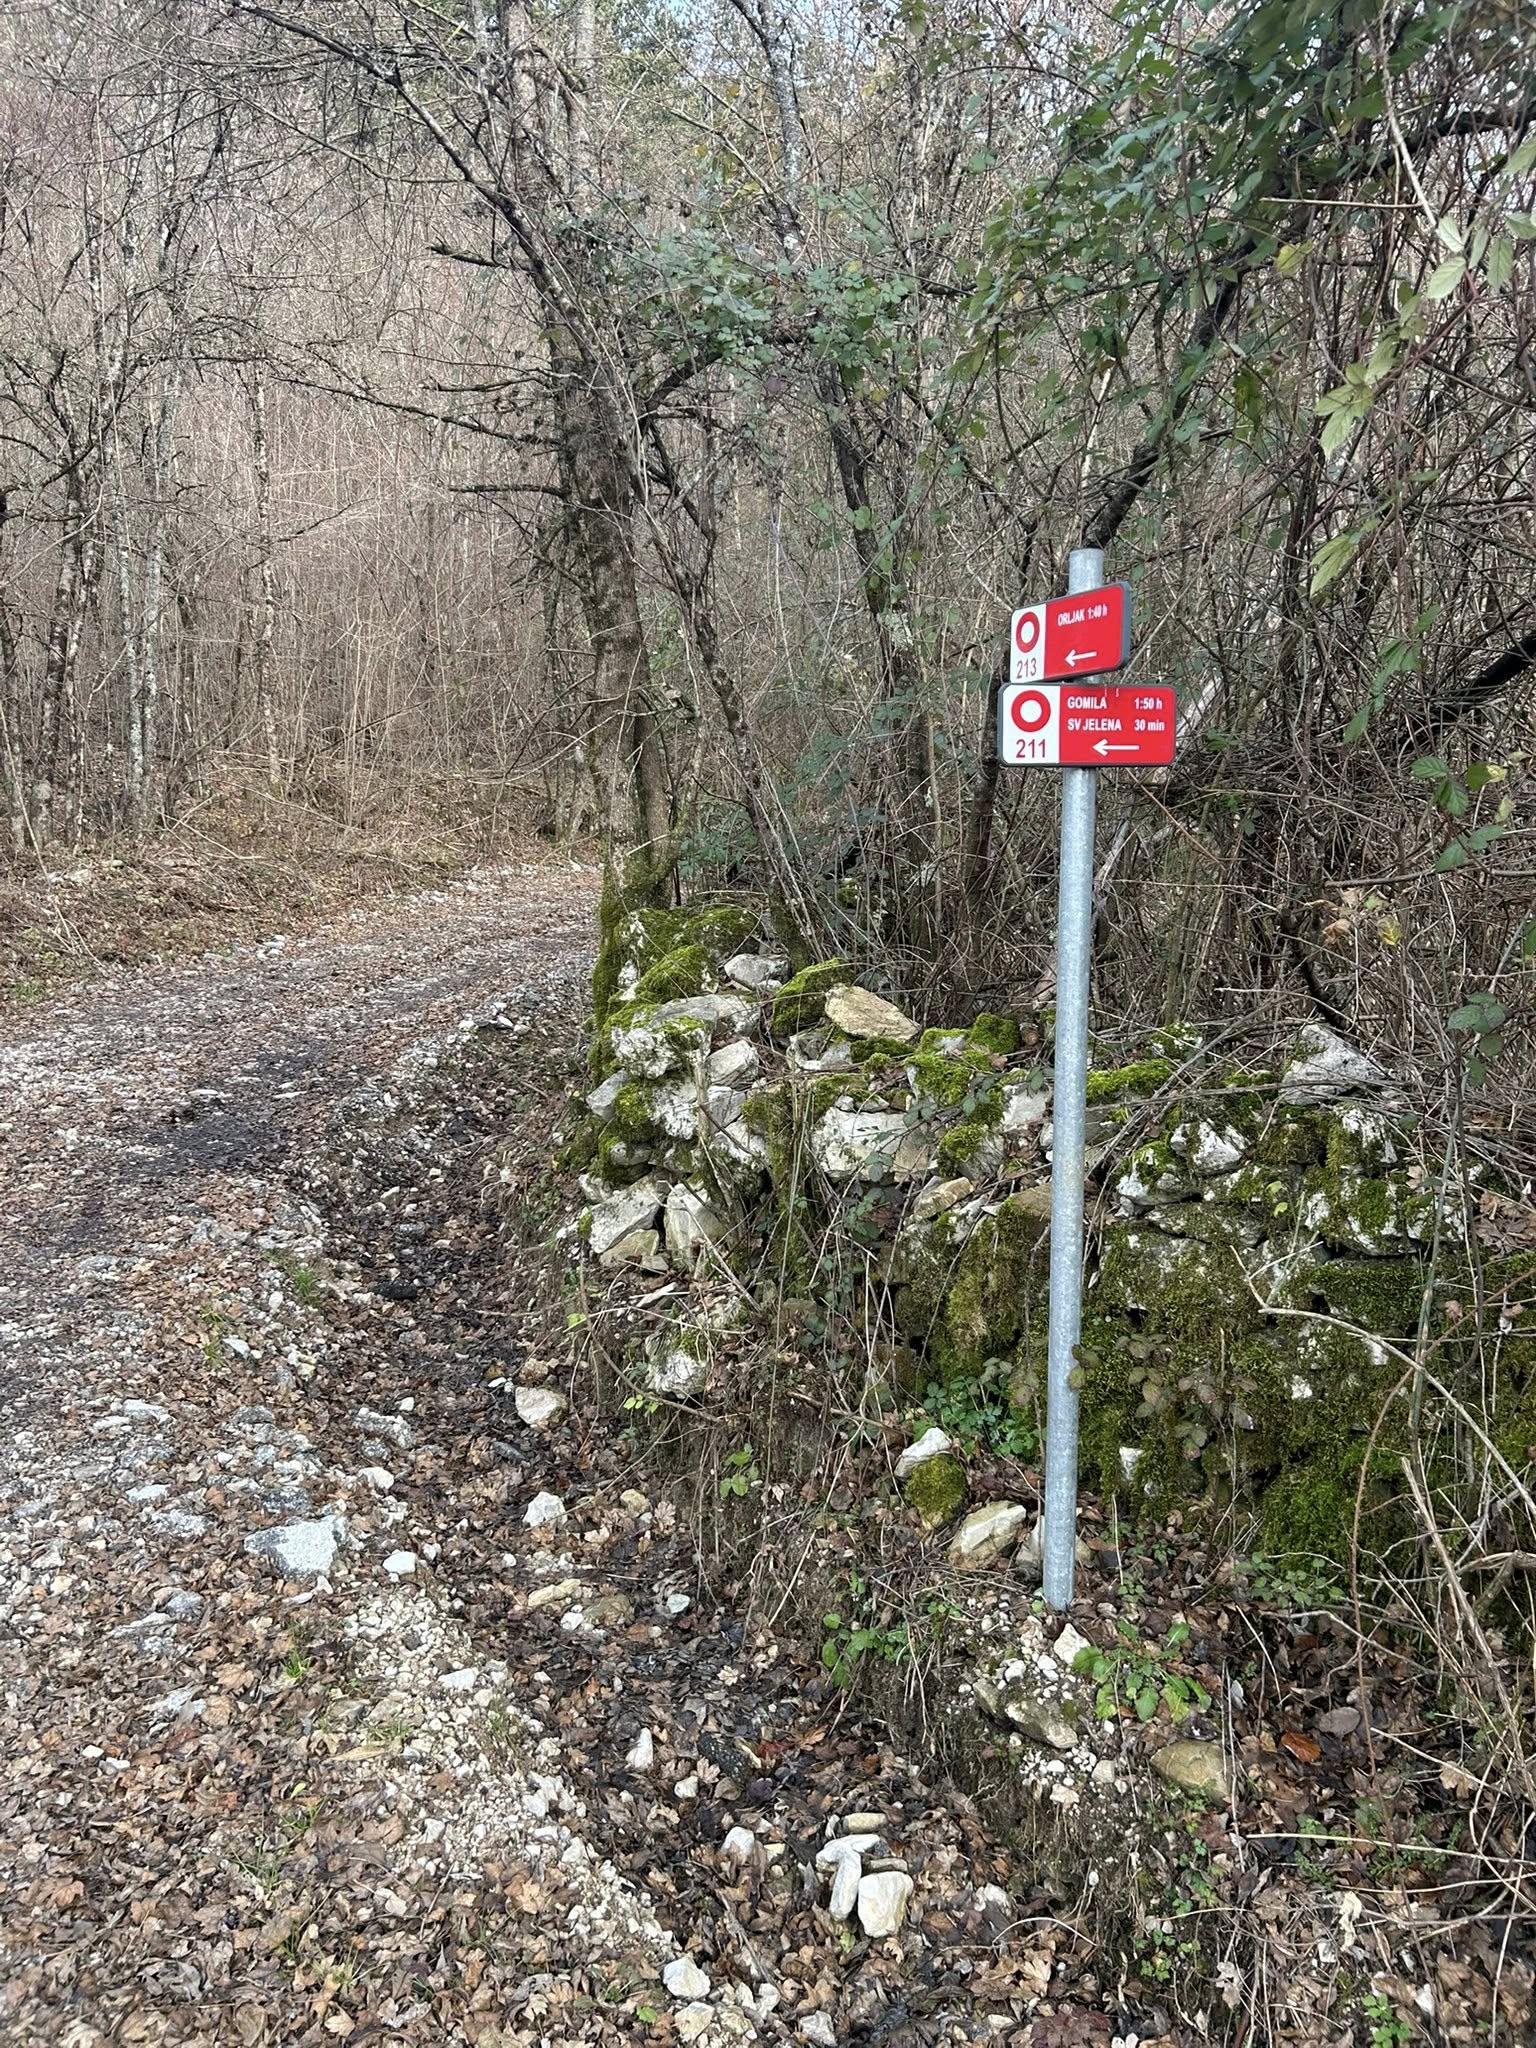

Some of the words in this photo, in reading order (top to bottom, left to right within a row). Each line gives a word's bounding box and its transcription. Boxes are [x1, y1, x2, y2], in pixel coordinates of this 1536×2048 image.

[1057, 608, 1085, 626] ORLJAK
[1016, 657, 1037, 679] 213
[1067, 696, 1107, 709] GOMILA
[1134, 697, 1155, 710] 1:50
[1156, 697, 1163, 710] h
[1067, 718, 1081, 731] SV
[1082, 718, 1122, 731] JELENA
[1134, 719, 1146, 731] 30
[1147, 719, 1165, 731] min
[1015, 738, 1046, 758] 211
